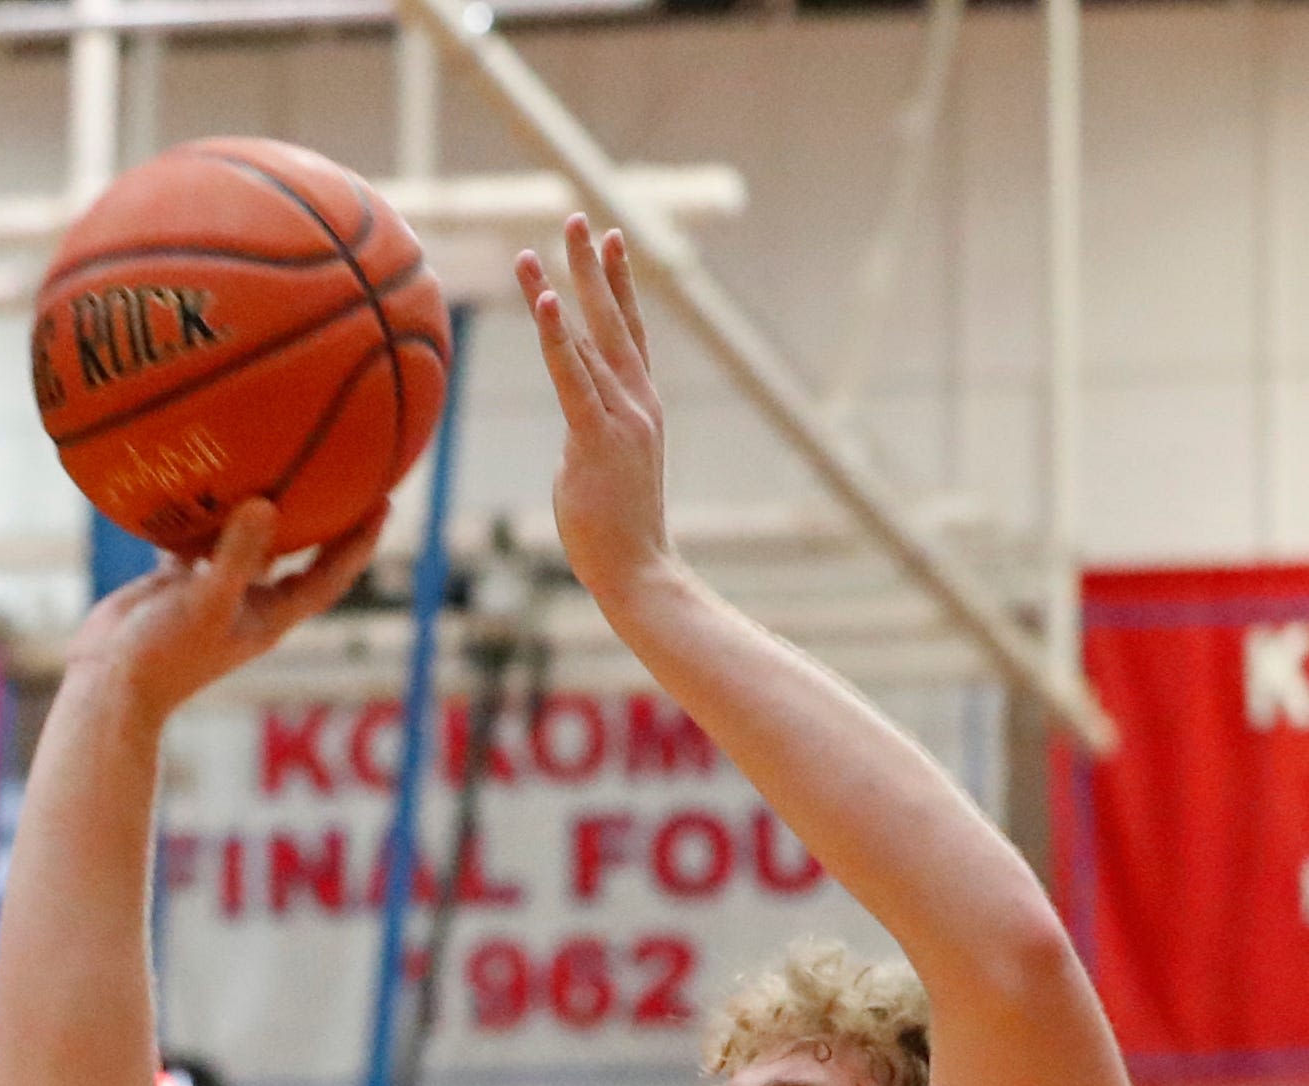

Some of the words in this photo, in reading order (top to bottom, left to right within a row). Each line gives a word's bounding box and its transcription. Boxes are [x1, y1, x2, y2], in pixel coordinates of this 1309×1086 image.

[70, 285, 225, 388] ROCK
[260, 692, 719, 796] KOKOM
[571, 805, 824, 902] FOU
[400, 932, 701, 1034] 962
